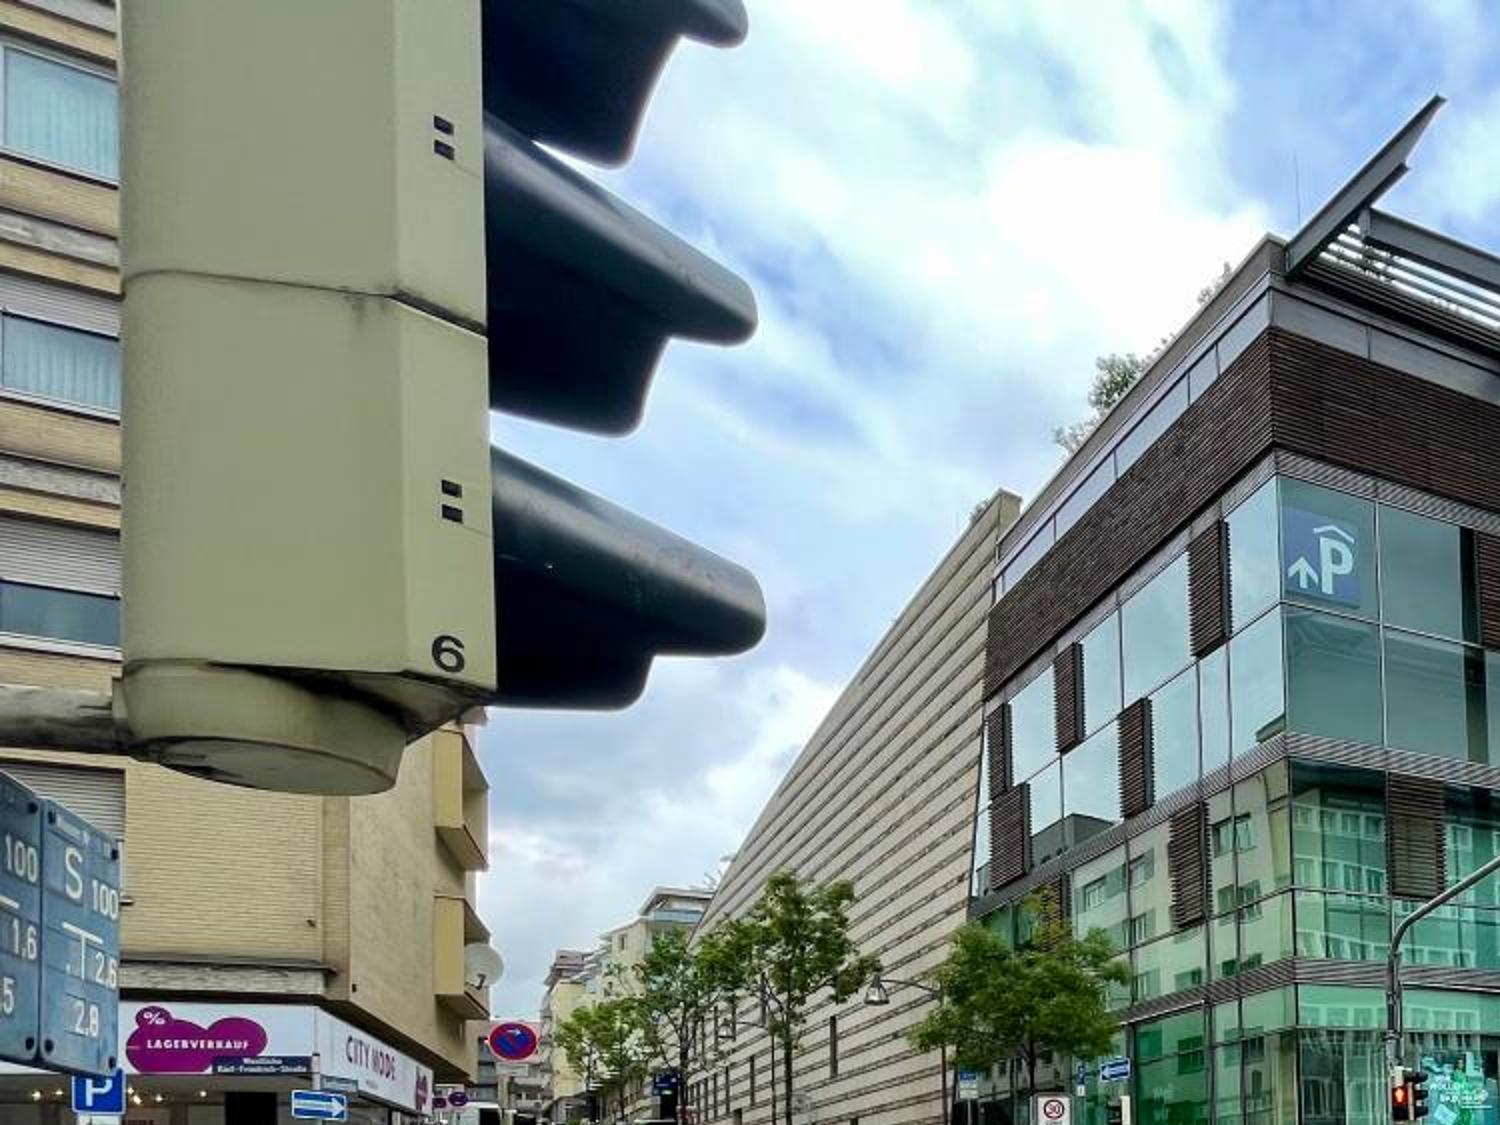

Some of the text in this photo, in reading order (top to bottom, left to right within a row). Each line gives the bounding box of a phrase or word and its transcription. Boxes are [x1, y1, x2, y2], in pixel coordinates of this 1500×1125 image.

[431, 634, 466, 674] 6
[5, 834, 38, 884] 100
[65, 847, 83, 900] S
[92, 879, 119, 921] 100
[147, 1039, 249, 1050] LAGERVERKAUF
[346, 1034, 396, 1081] CITY MODE
[85, 1077, 113, 1107] P
